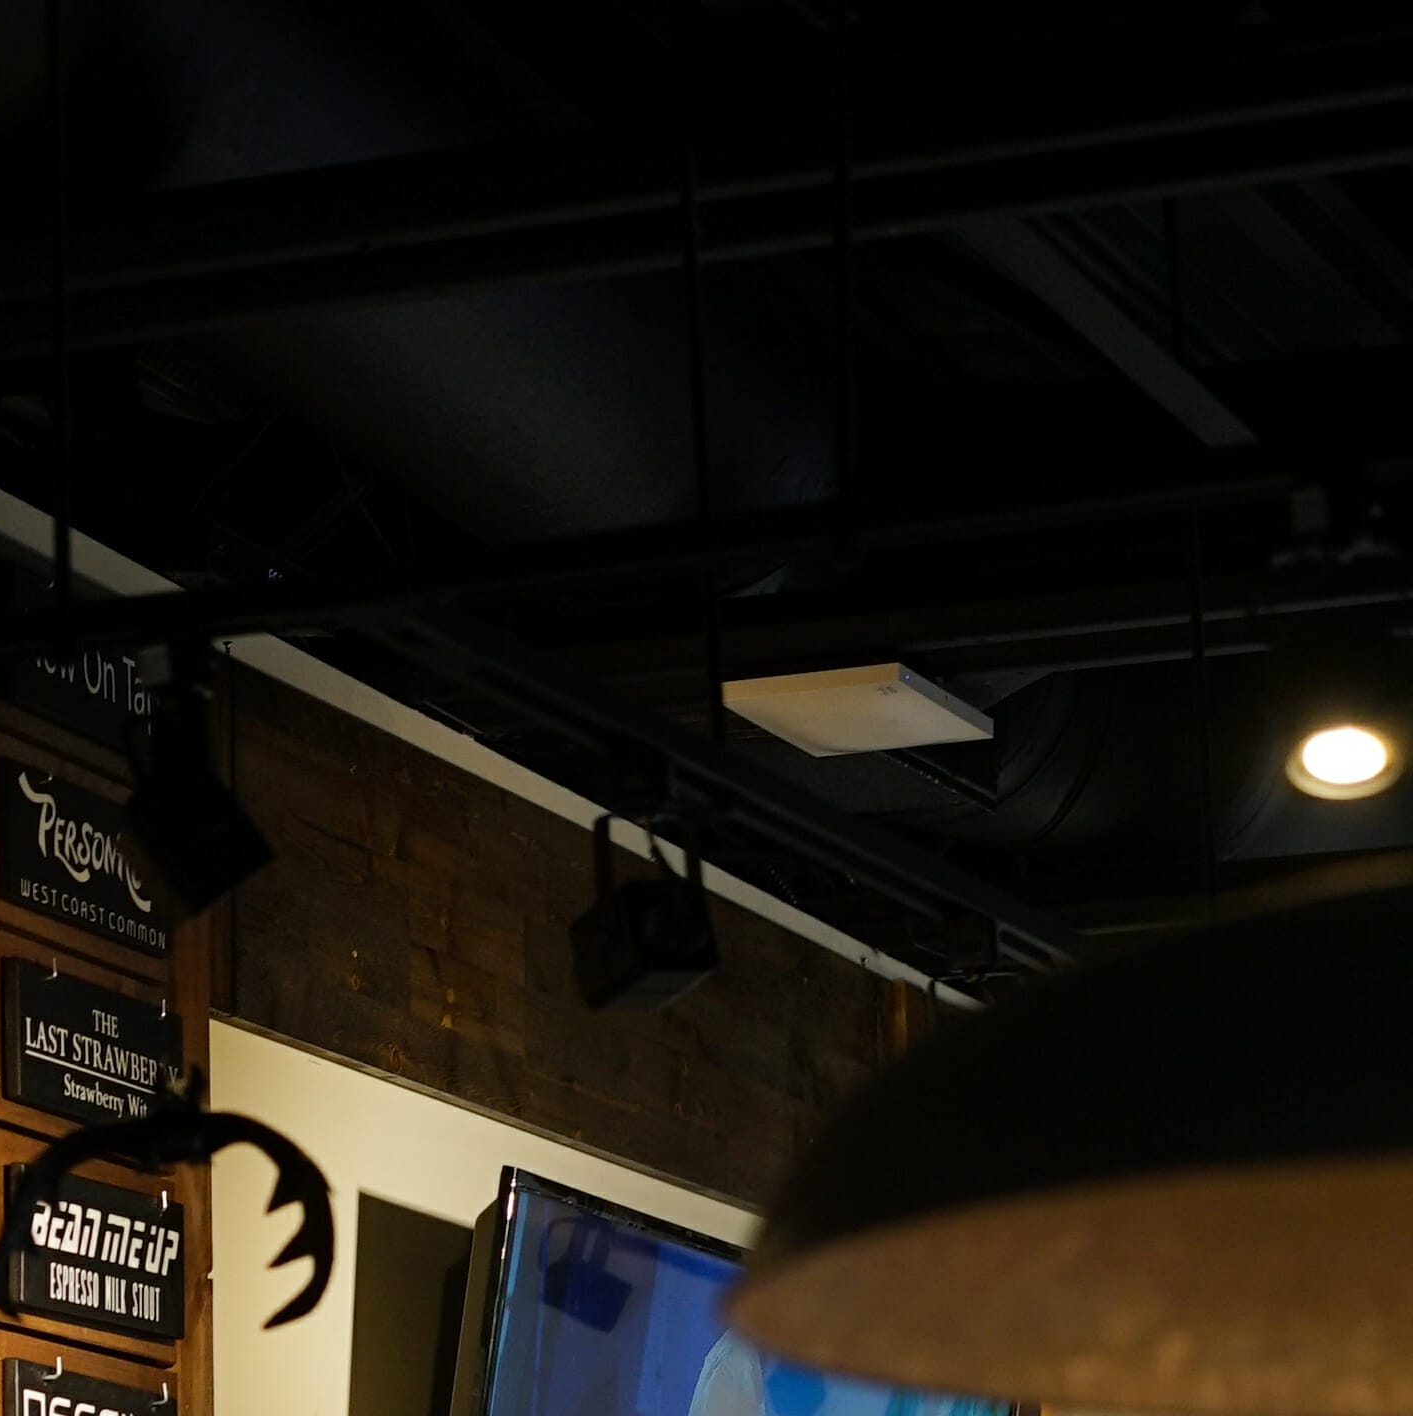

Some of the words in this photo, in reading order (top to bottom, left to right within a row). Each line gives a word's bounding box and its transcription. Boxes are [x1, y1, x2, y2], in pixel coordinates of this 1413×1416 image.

[21, 878, 57, 907] WEST
[61, 893, 105, 926] COAST
[108, 907, 166, 950] COMMON
[25, 1017, 68, 1057] LAST
[92, 1009, 119, 1038] THE
[63, 1073, 125, 1117] Strawberry
[127, 1094, 148, 1119] Wit
[145, 1224, 179, 1277] UP
[50, 1262, 99, 1307] ESPRESSO
[105, 1275, 126, 1314] MILK
[132, 1283, 160, 1322] STOUT
